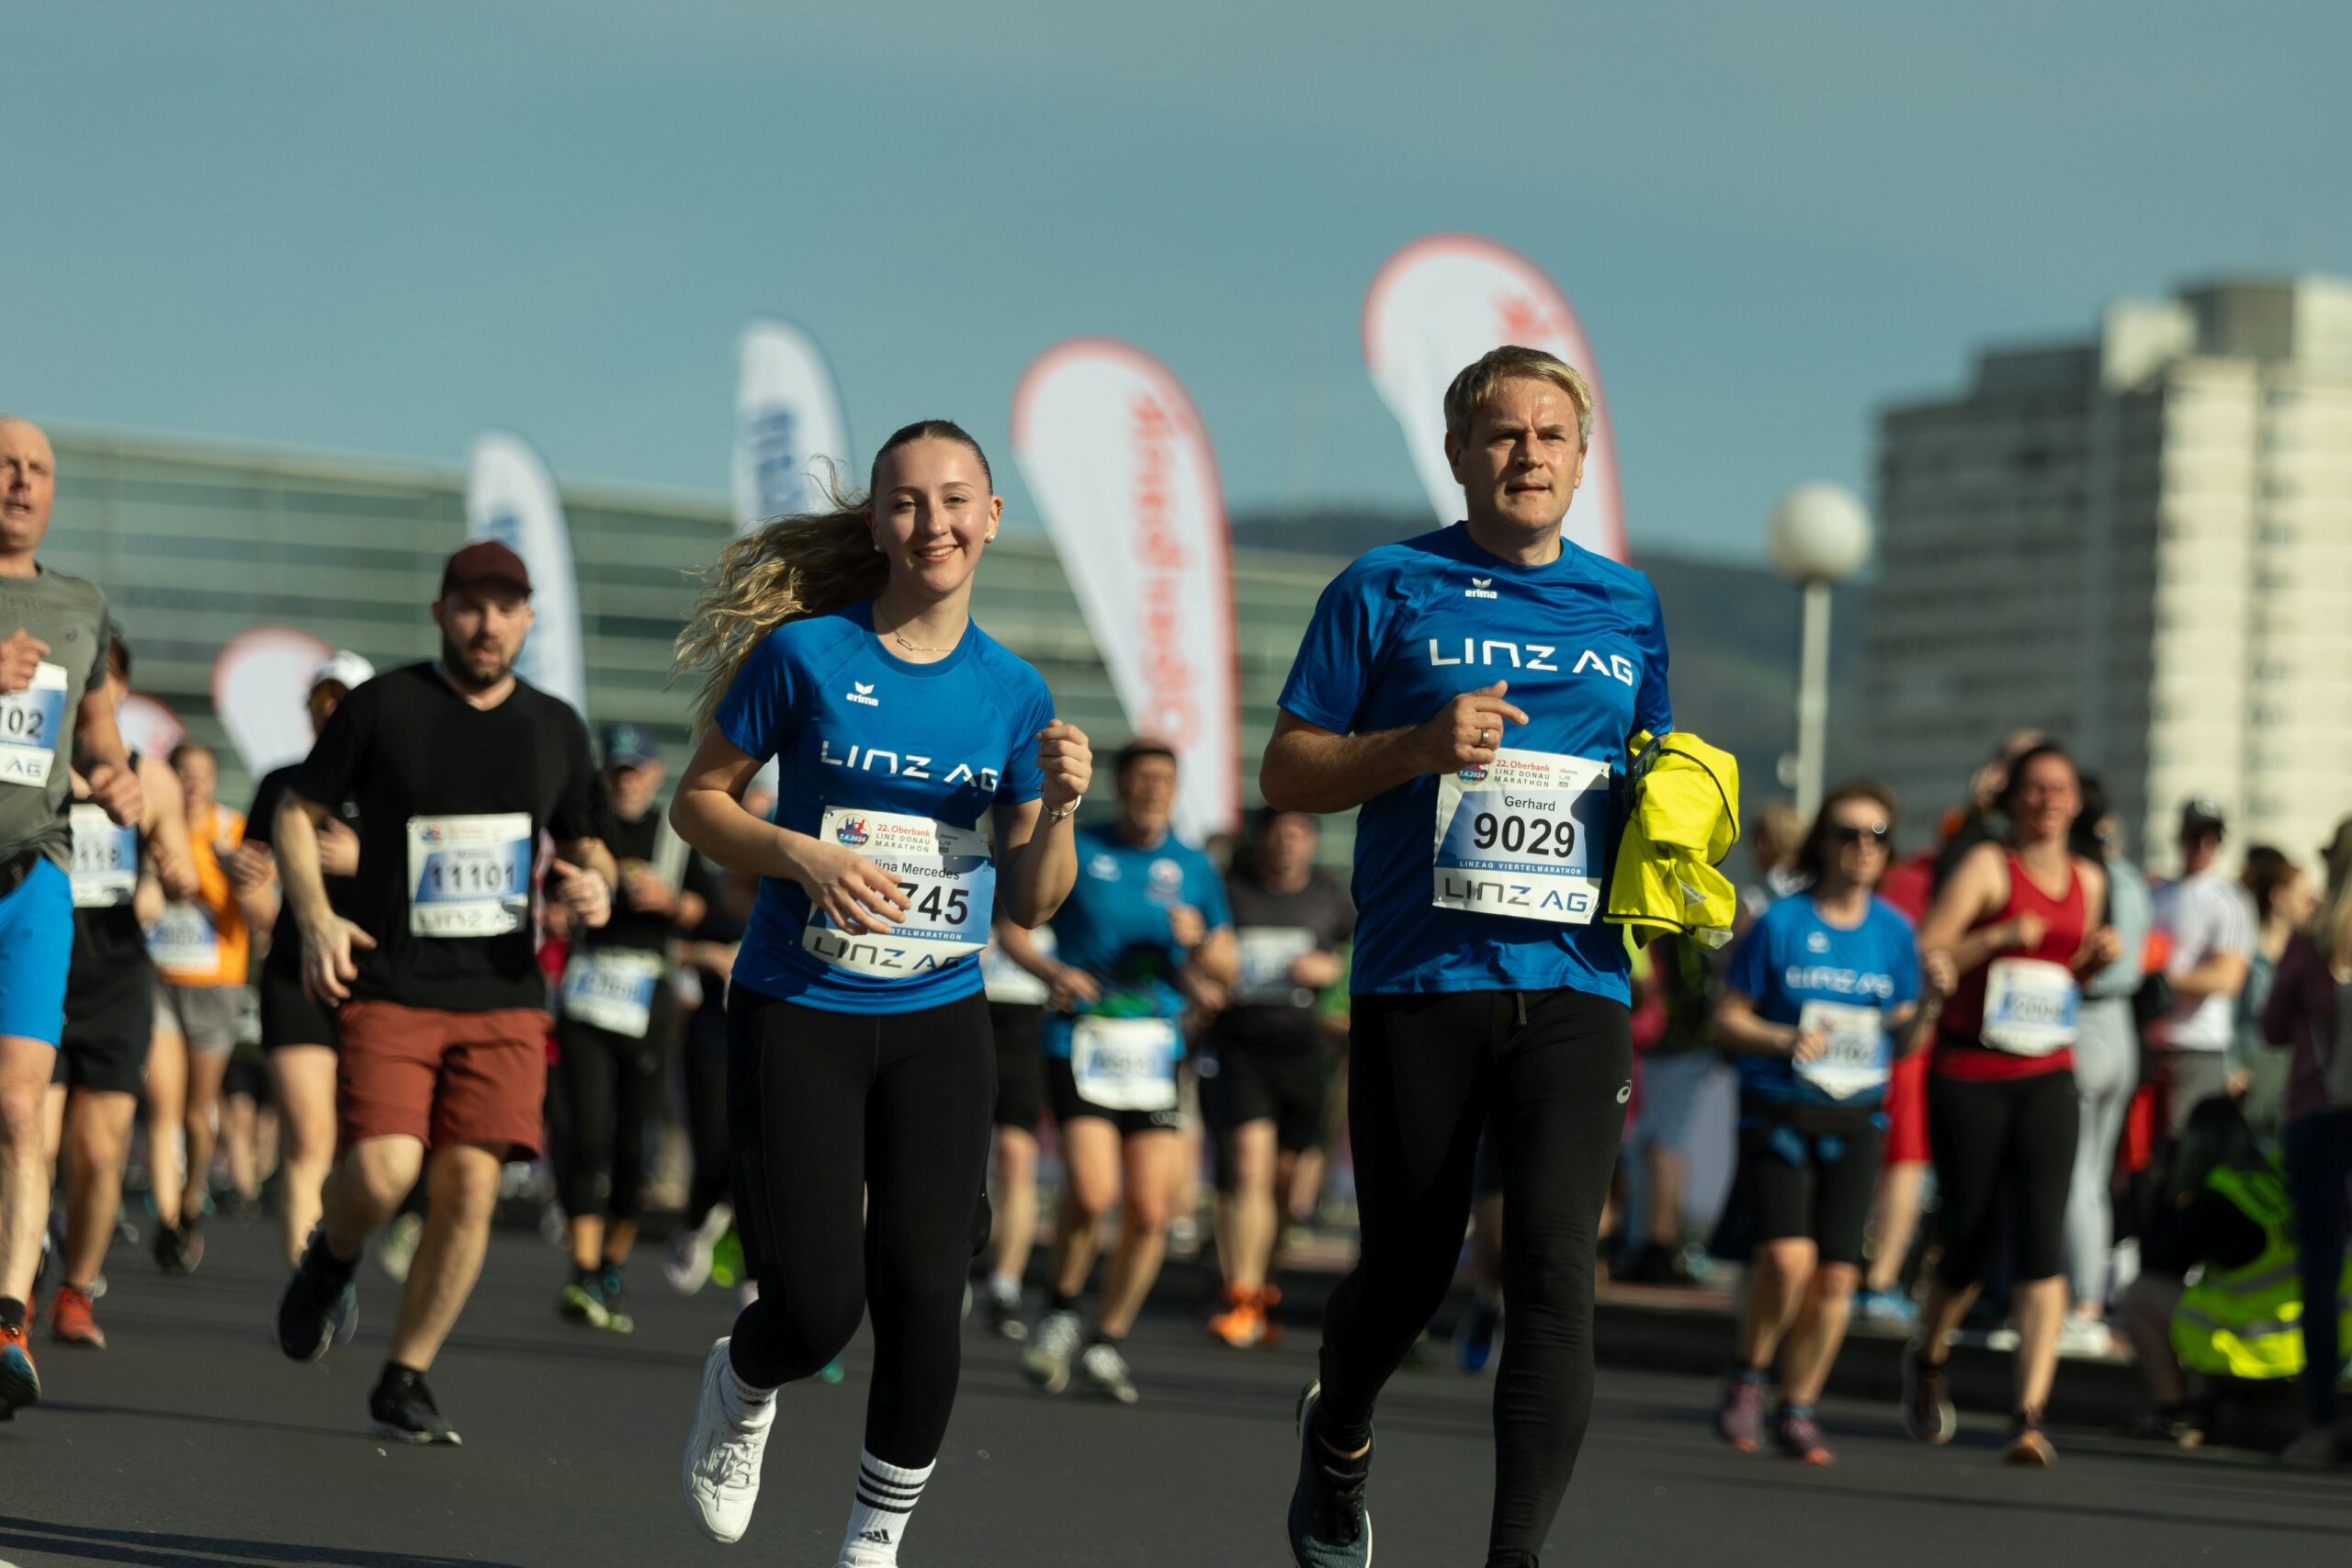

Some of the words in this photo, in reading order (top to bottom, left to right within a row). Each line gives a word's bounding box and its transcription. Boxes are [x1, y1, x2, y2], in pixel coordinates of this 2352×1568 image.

[1464, 589, 1498, 599] erima
[1572, 649, 1634, 687] AG
[846, 693, 879, 706] erima
[1496, 760, 1509, 768] 22.
[1510, 761, 1551, 773] Oberbank
[944, 763, 999, 793] AG
[1495, 768, 1514, 776] LINZ
[1519, 771, 1551, 780] DONAU
[1494, 776, 1550, 788] MARATHON
[1504, 795, 1555, 812] Gerhard
[877, 823, 889, 832] 22.
[891, 825, 931, 838] Oberbank
[1473, 812, 1575, 858] 9029
[876, 832, 896, 840] LINZ
[899, 835, 931, 845] DONAU
[875, 840, 929, 852] MARATHON
[430, 860, 515, 891] 11101
[875, 858, 898, 873] lina
[901, 862, 960, 880] Mercedes
[1498, 863, 1581, 874] VIERTELMARATHON
[869, 882, 970, 925] 745
[1540, 889, 1589, 912] AG
[889, 927, 962, 940] RTELMARATHON
